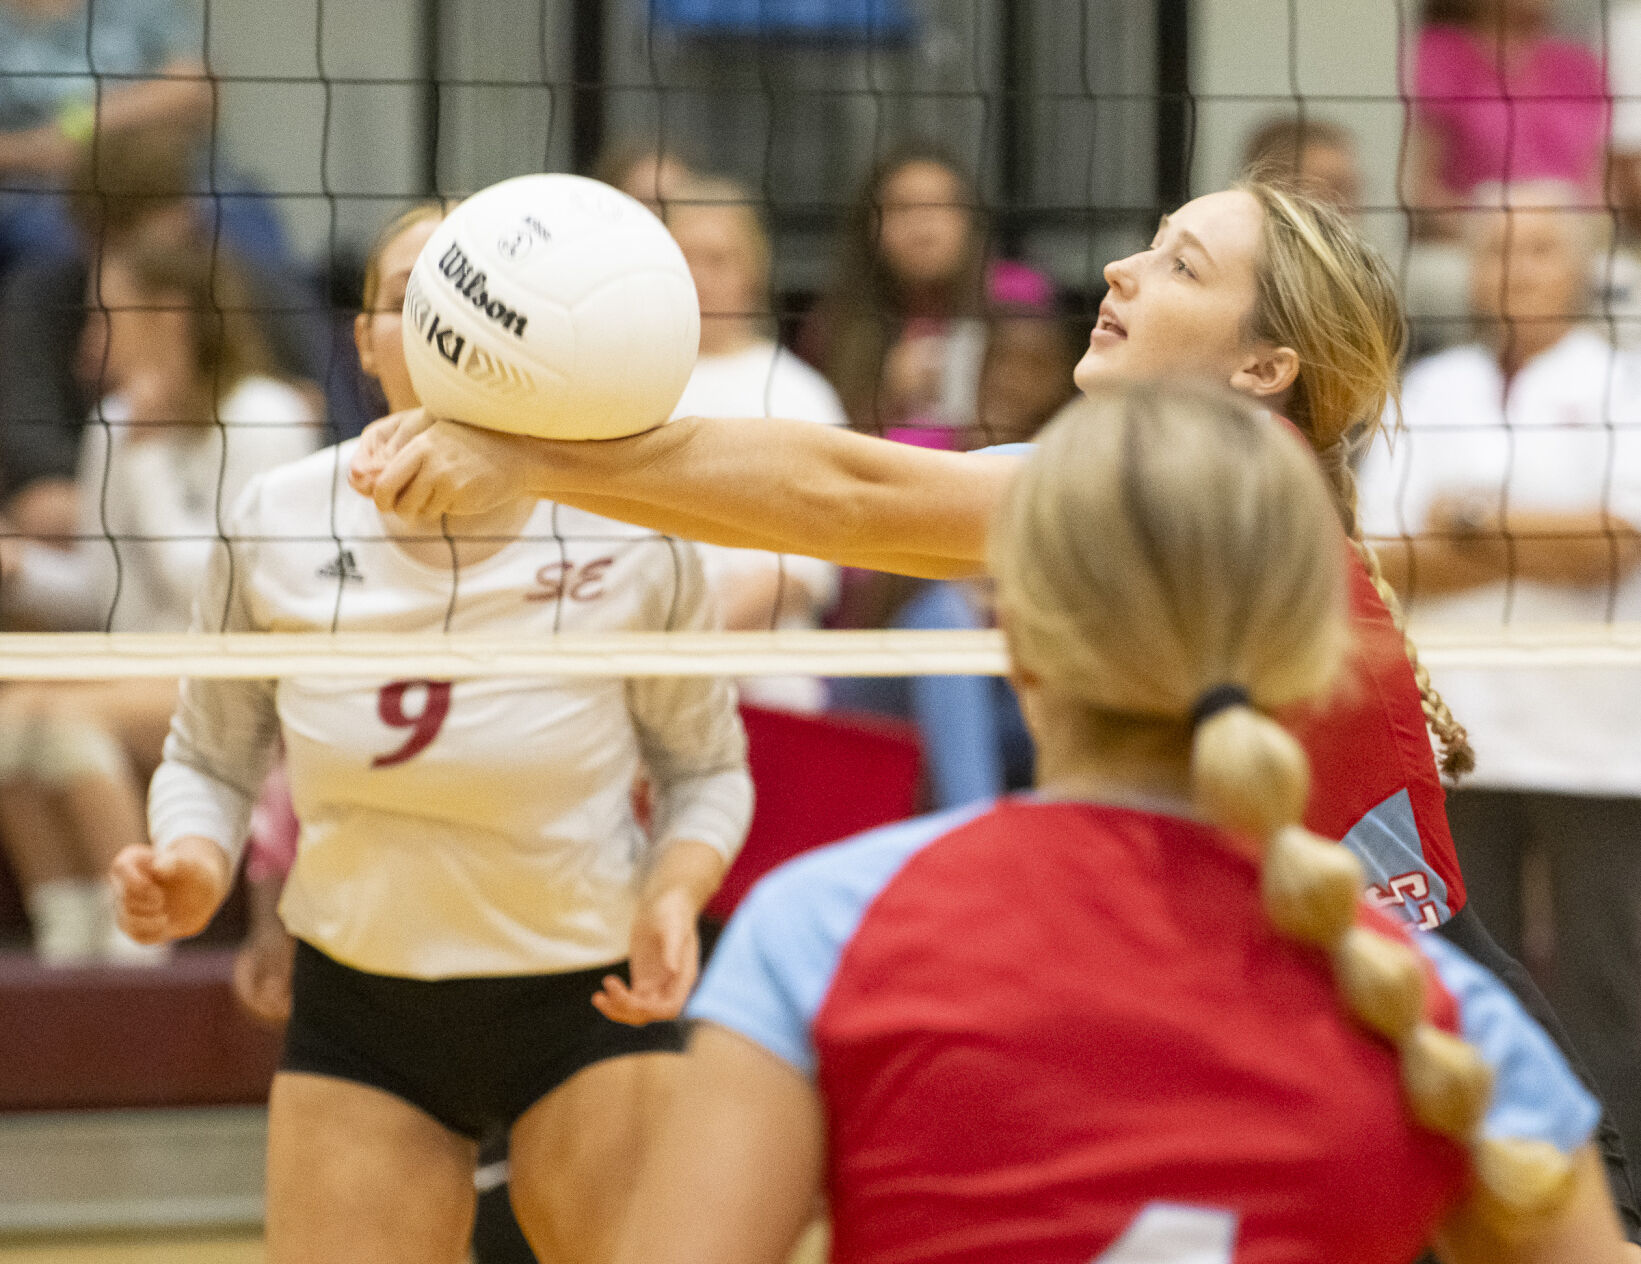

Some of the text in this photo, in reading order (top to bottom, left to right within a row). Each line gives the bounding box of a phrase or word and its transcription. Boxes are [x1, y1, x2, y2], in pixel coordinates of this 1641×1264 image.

[438, 241, 528, 337] Wilson
[522, 555, 614, 603] SE
[371, 679, 451, 768] 9
